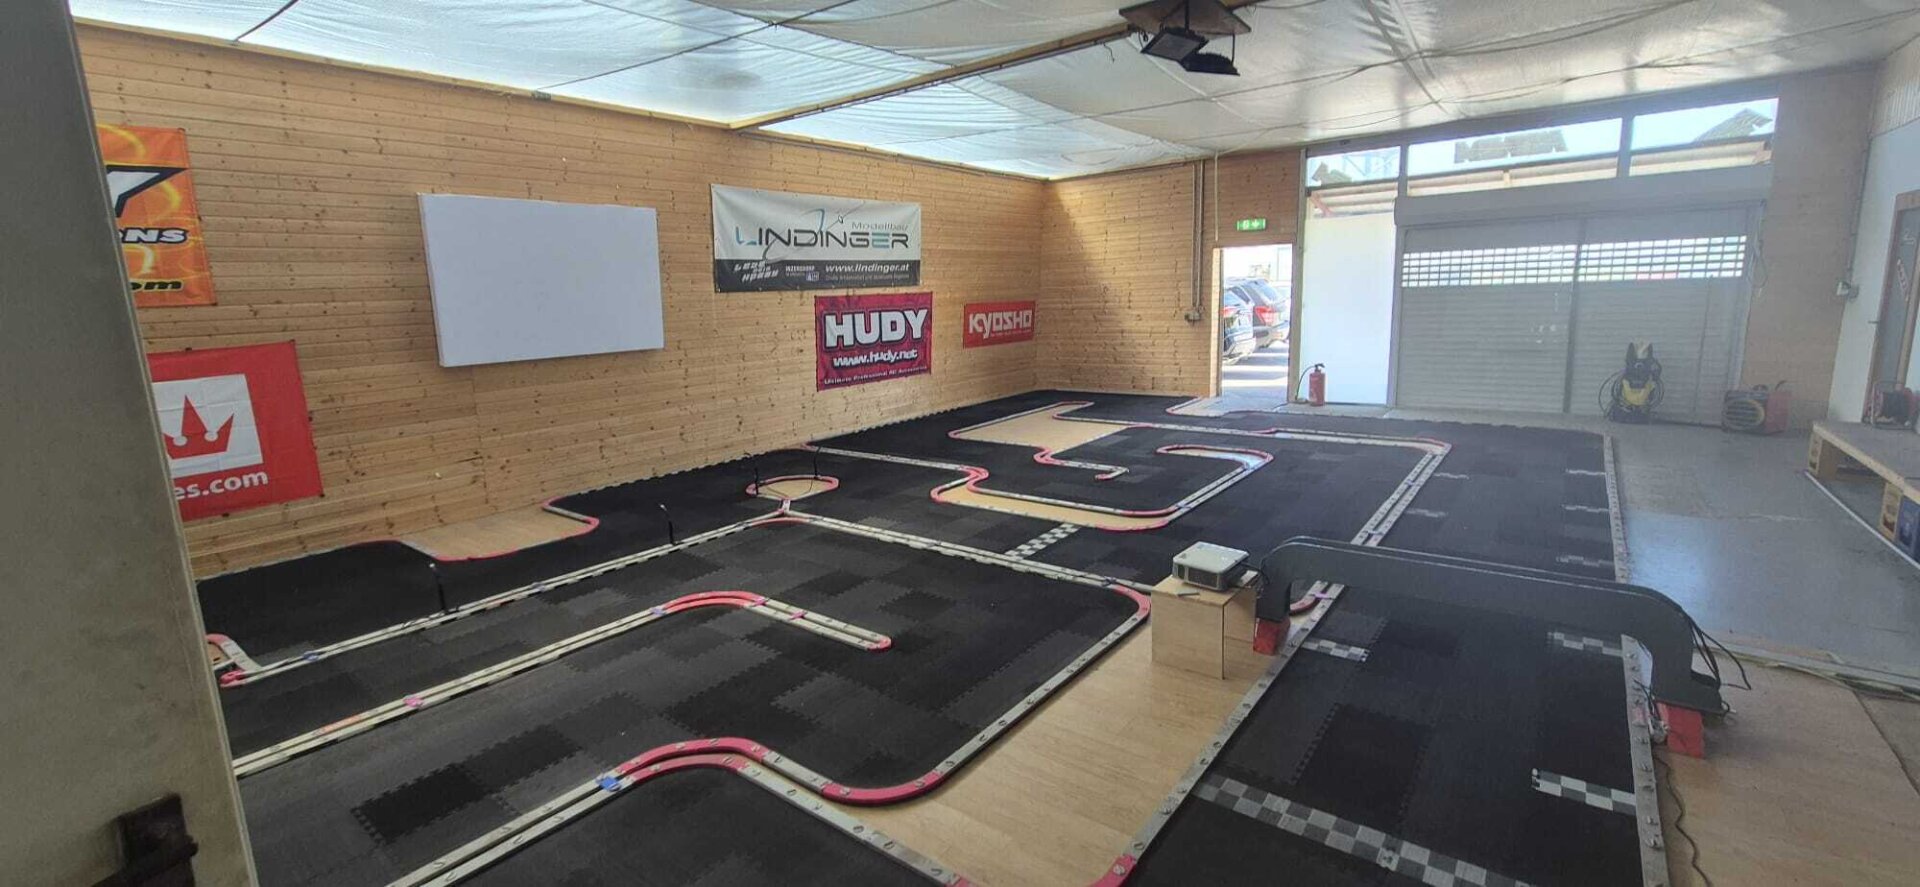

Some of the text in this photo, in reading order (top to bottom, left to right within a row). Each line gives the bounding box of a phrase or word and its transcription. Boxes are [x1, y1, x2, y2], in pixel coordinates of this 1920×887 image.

[119, 228, 186, 243] NS
[735, 226, 909, 249] LINDINGER
[825, 263, 909, 274] www.lindinger.at
[824, 309, 928, 348] HUDY
[833, 349, 918, 367] www.hudy.net
[174, 471, 269, 500] es.com
